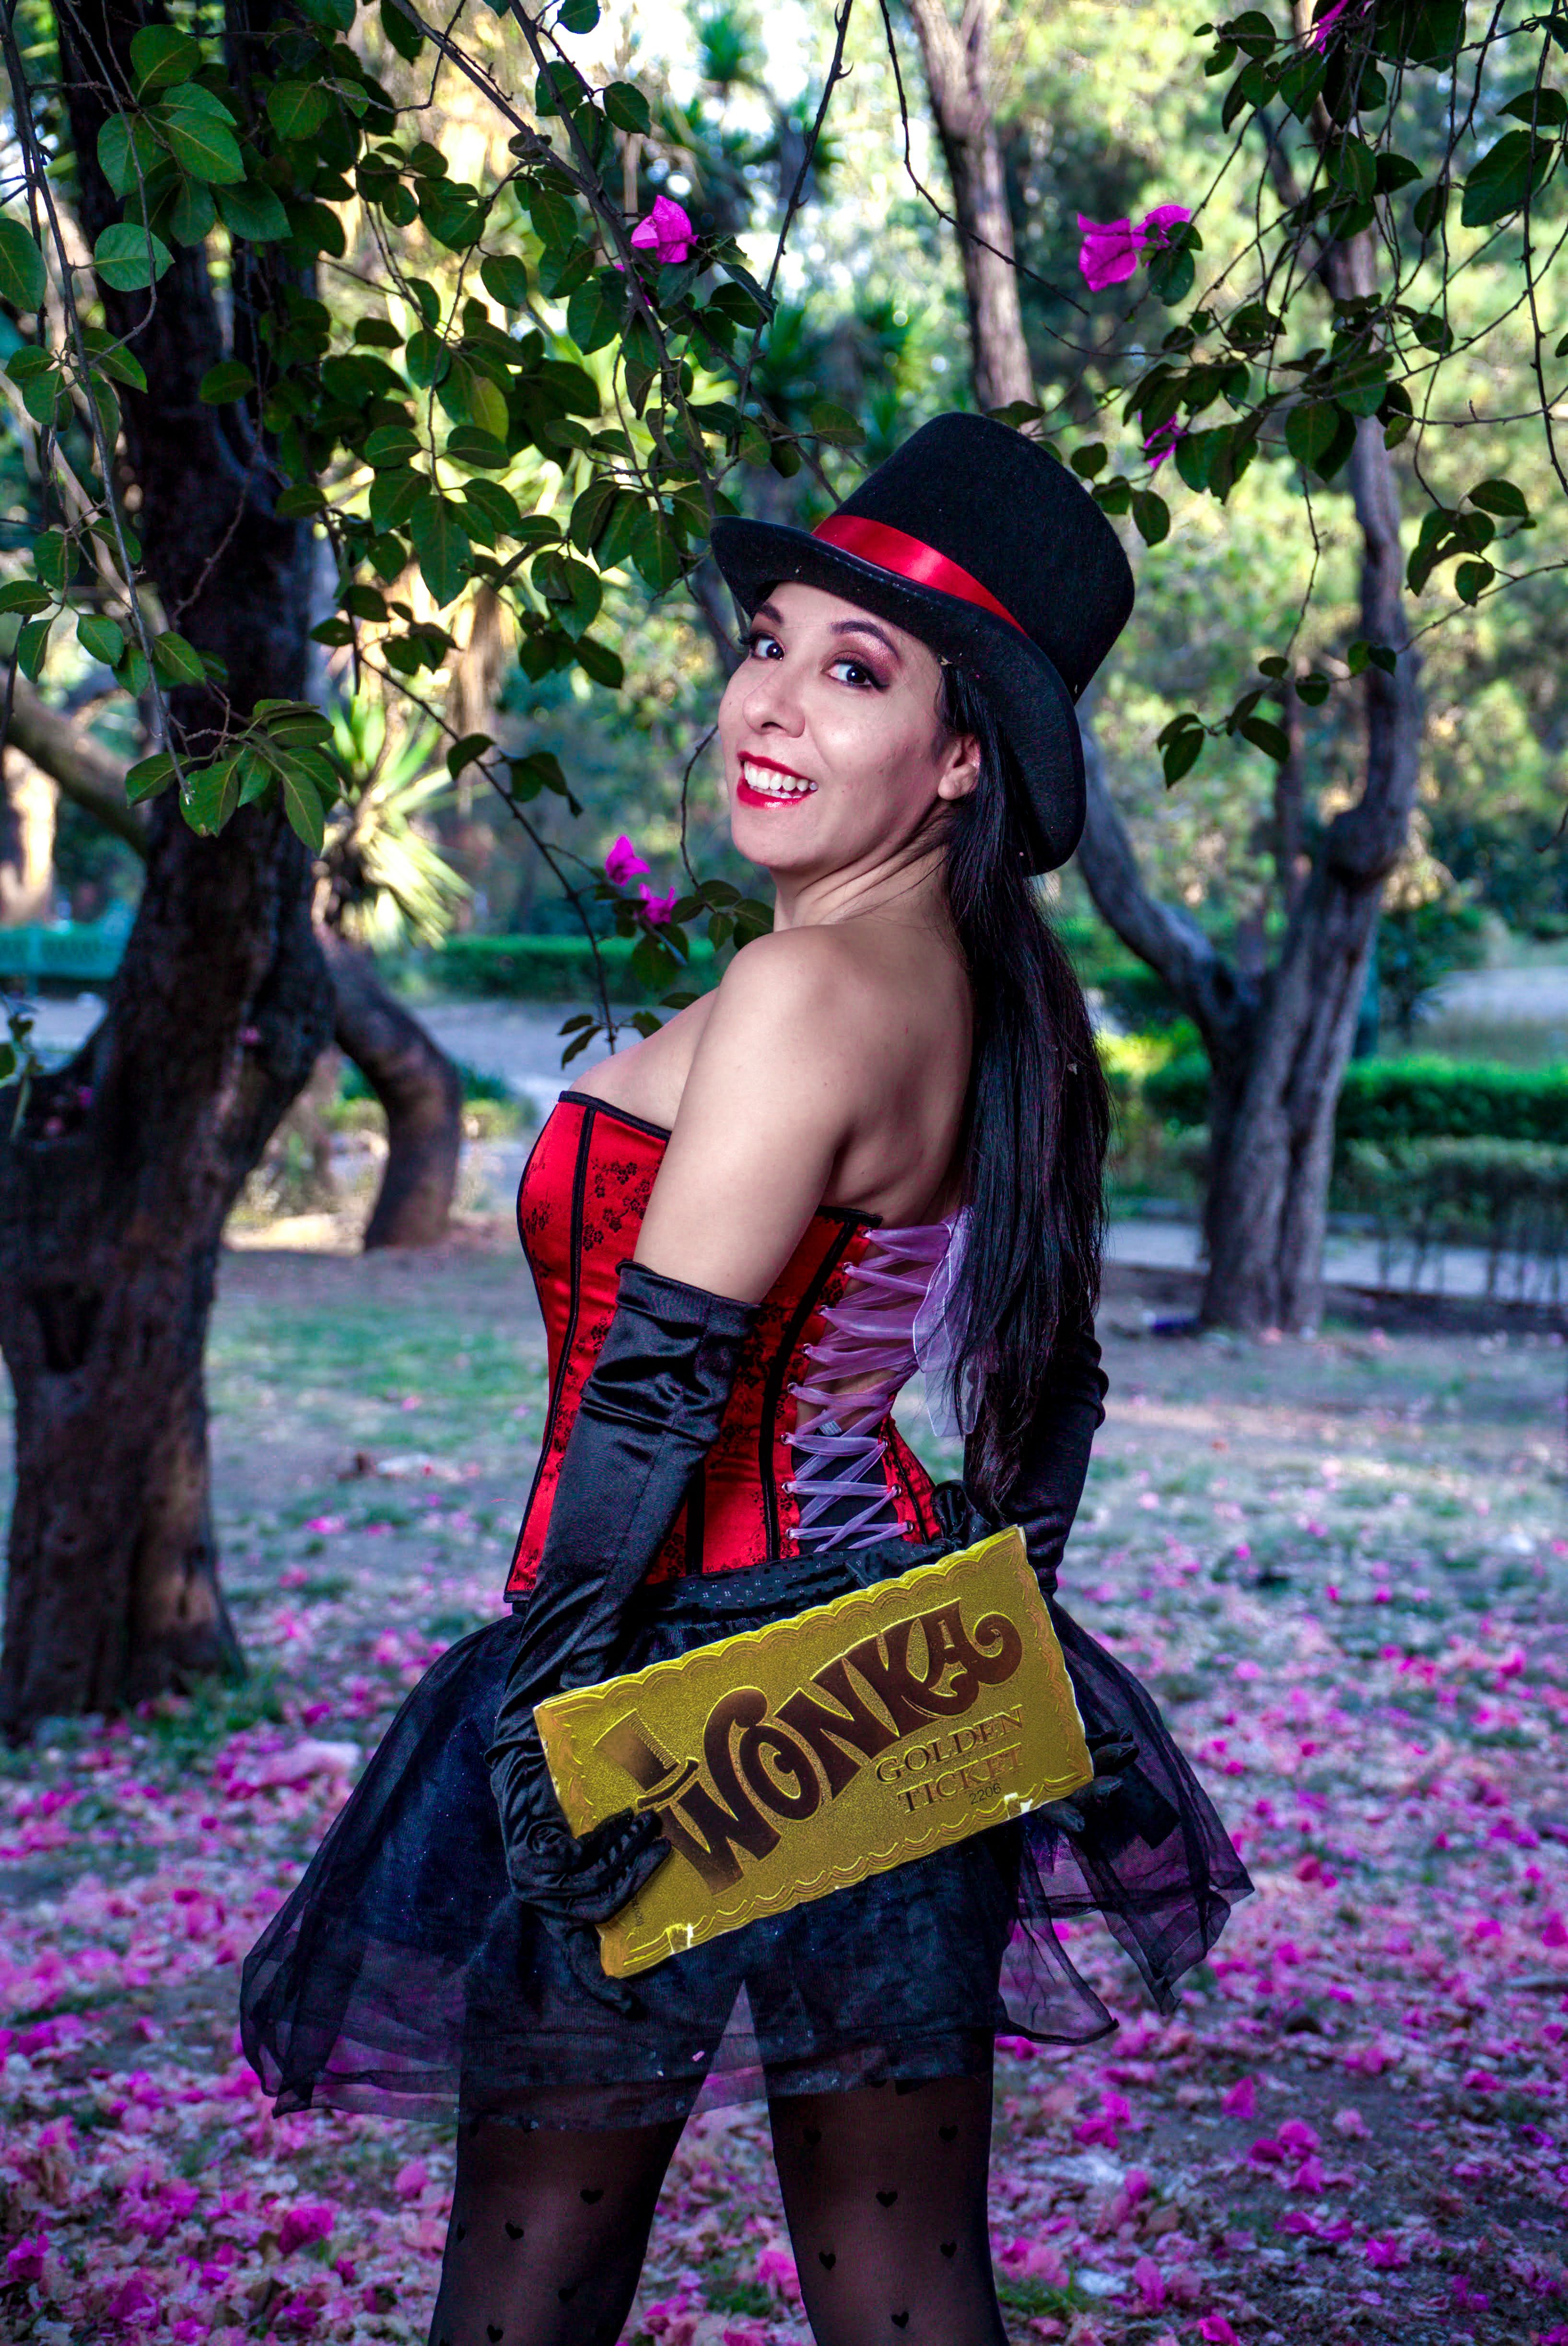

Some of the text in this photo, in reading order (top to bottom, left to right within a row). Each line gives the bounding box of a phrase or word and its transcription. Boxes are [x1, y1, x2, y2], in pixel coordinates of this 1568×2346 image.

[660, 1597, 1022, 1896] WONKA
[875, 1704, 1023, 1785] GOLDEN
[896, 1742, 1023, 1814] TICKET
[969, 1783, 1001, 1805] 2206
